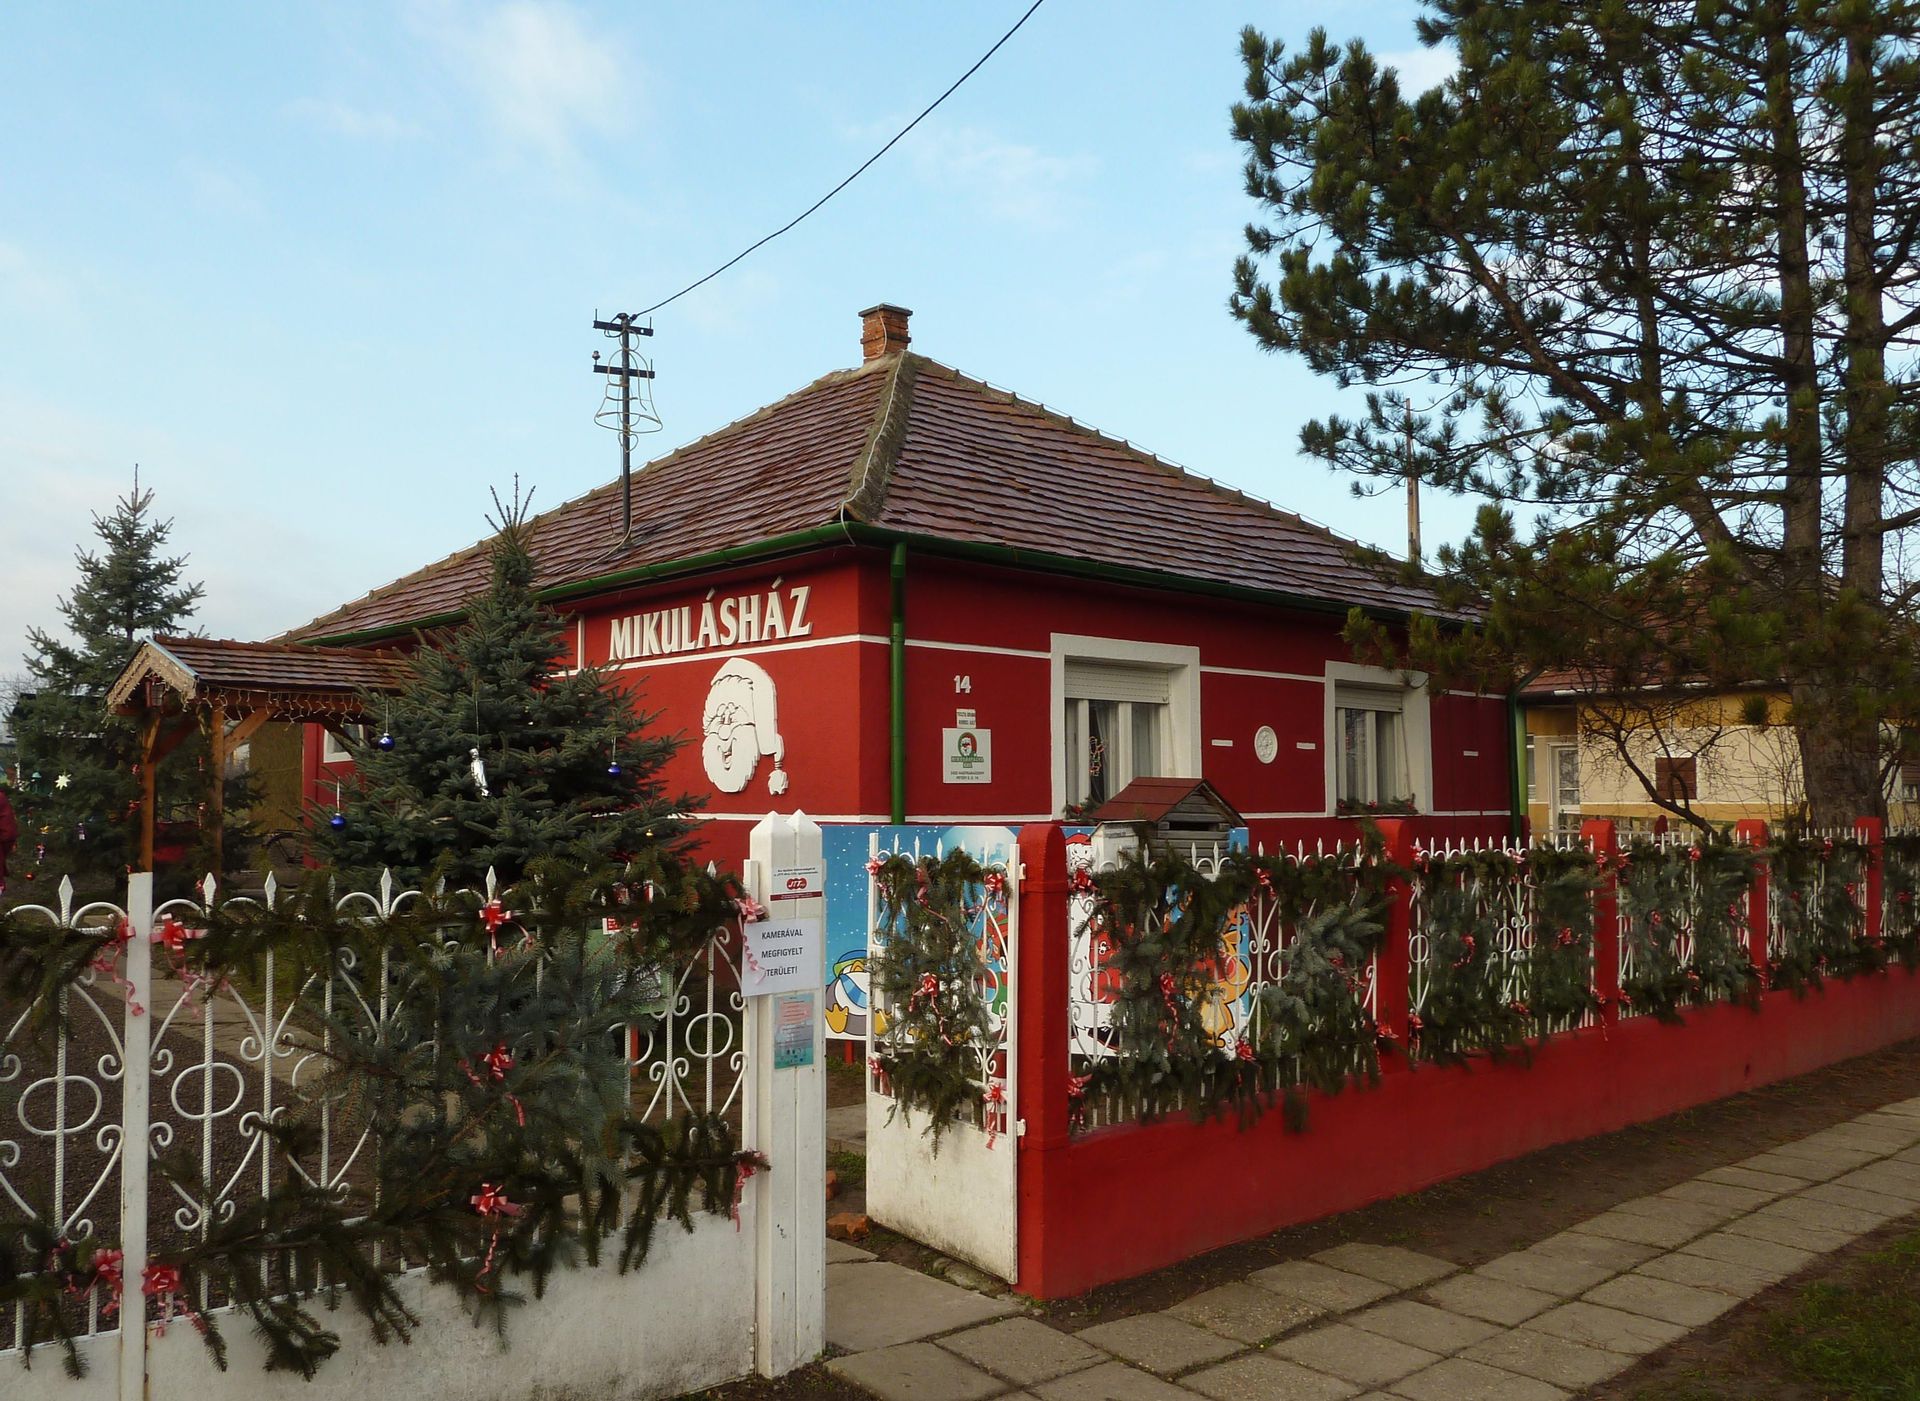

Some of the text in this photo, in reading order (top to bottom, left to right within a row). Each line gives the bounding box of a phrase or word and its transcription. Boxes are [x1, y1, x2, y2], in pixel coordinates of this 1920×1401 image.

[609, 576, 813, 661] MIKULÁSHÁZ
[953, 675, 971, 693] 14
[761, 928, 804, 940] KAMERÁVAL
[761, 947, 804, 959] MEGFIGYELT
[766, 965, 798, 977] TERÜLET!
